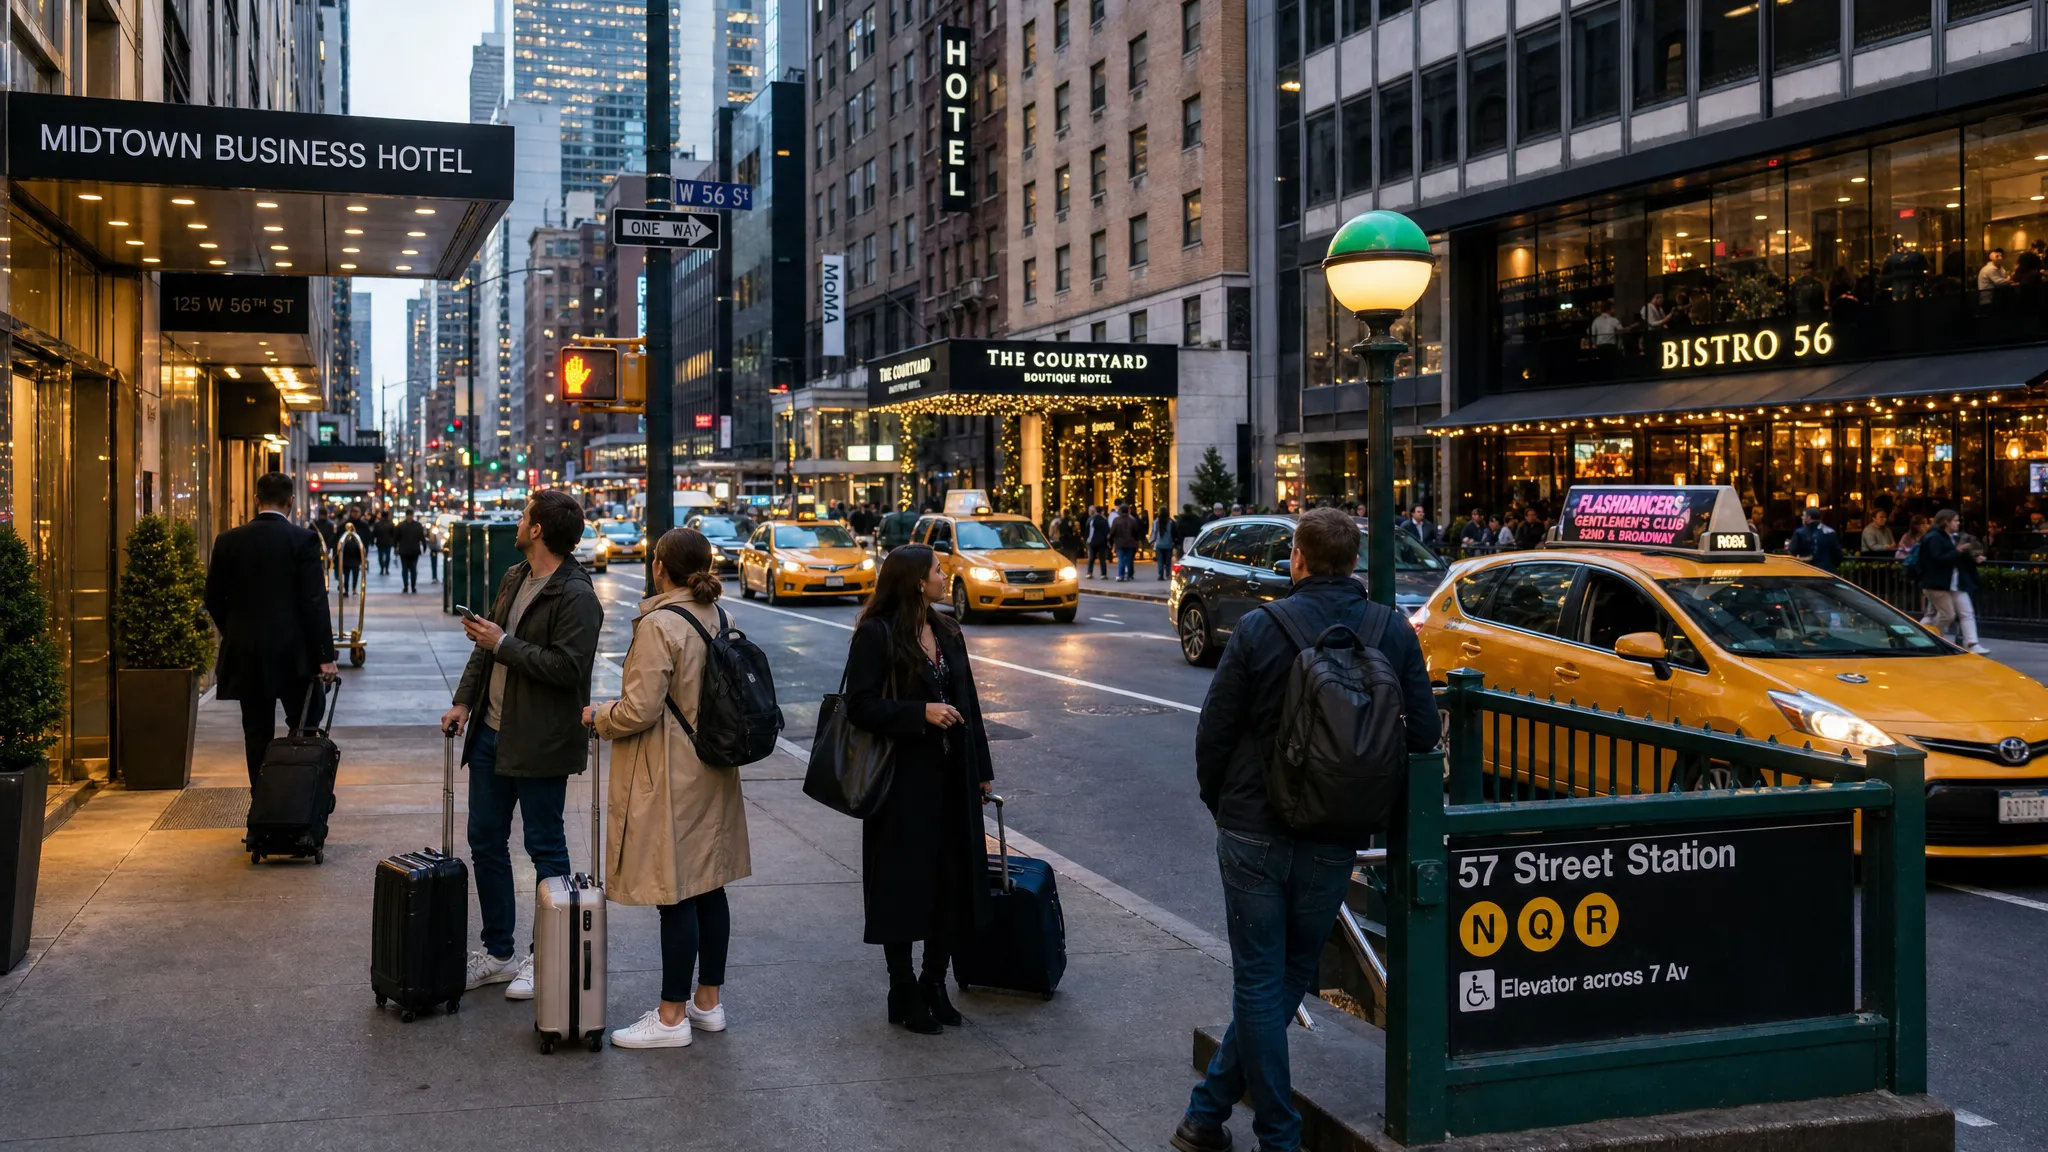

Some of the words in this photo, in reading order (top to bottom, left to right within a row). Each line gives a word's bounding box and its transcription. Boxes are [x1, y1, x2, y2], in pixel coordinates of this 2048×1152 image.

[945, 39, 967, 197] HOTEL
[40, 123, 201, 160] MIDTOWN
[215, 134, 366, 169] BUSINESS
[378, 144, 472, 175] HOTEL
[679, 183, 694, 203] W
[702, 185, 725, 205] 56
[631, 221, 661, 236] ONE
[672, 223, 702, 238] WAY
[172, 296, 201, 312] 125
[207, 297, 224, 313] W
[230, 297, 267, 313] 56TH
[273, 299, 294, 314] ST
[1661, 329, 1778, 370] BISTRO
[1794, 321, 1833, 357] 56
[892, 357, 931, 380] COURTYARD
[986, 349, 1026, 367] THE
[1033, 351, 1148, 370] COURTYARD
[1023, 372, 1076, 384] BOUTIQUE
[1080, 373, 1112, 384] HOTEL
[1576, 494, 1685, 516] FLASHDANCERS
[1574, 514, 1650, 530] GENTLEMEN'S
[1652, 517, 1685, 531] CLUB
[1618, 529, 1675, 544] BROADWAY
[1458, 854, 1499, 888] 57
[1513, 848, 1614, 884] Street
[1627, 840, 1736, 876] Station
[1472, 913, 1495, 945] N
[1528, 908, 1553, 941] Q
[1586, 904, 1608, 935] R
[1501, 974, 1578, 999] Elevator
[1583, 969, 1643, 991] across
[1649, 964, 1661, 983] 7
[1665, 962, 1690, 982] Av
